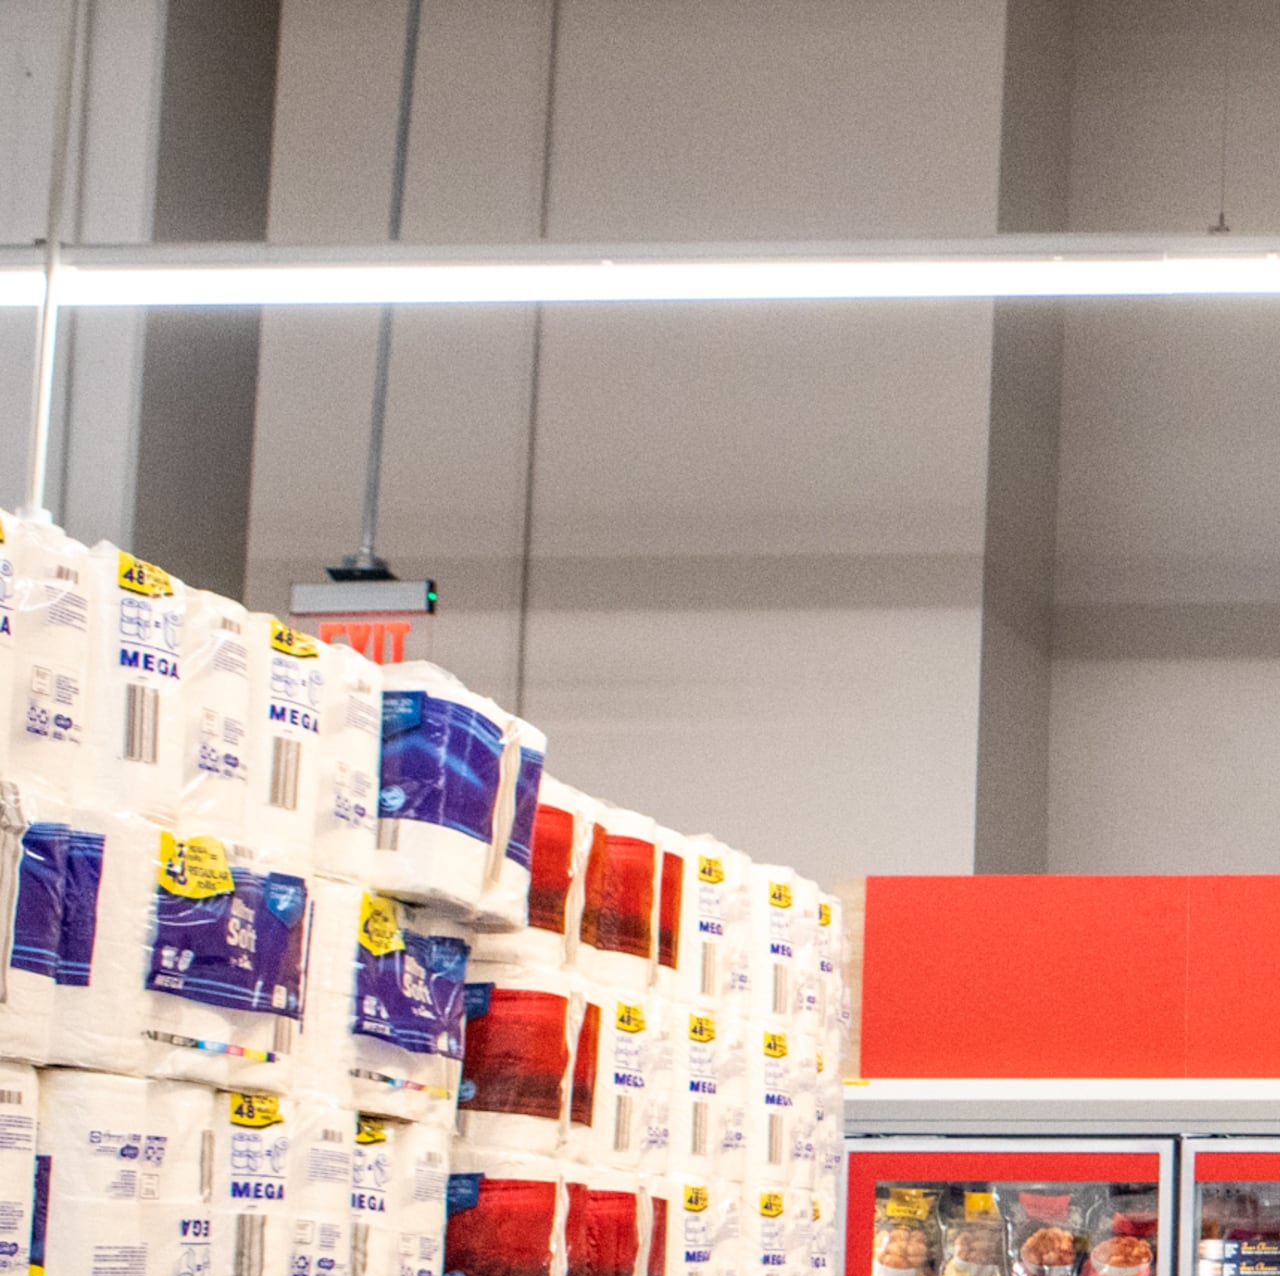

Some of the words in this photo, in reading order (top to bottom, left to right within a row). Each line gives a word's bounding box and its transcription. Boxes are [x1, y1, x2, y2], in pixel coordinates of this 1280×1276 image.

[122, 569, 146, 586] 48
[274, 630, 293, 648] 48
[119, 647, 180, 679] MEGA
[269, 703, 320, 734] MEGA
[234, 1103, 256, 1119] 48
[231, 1181, 284, 1200] MEGA
